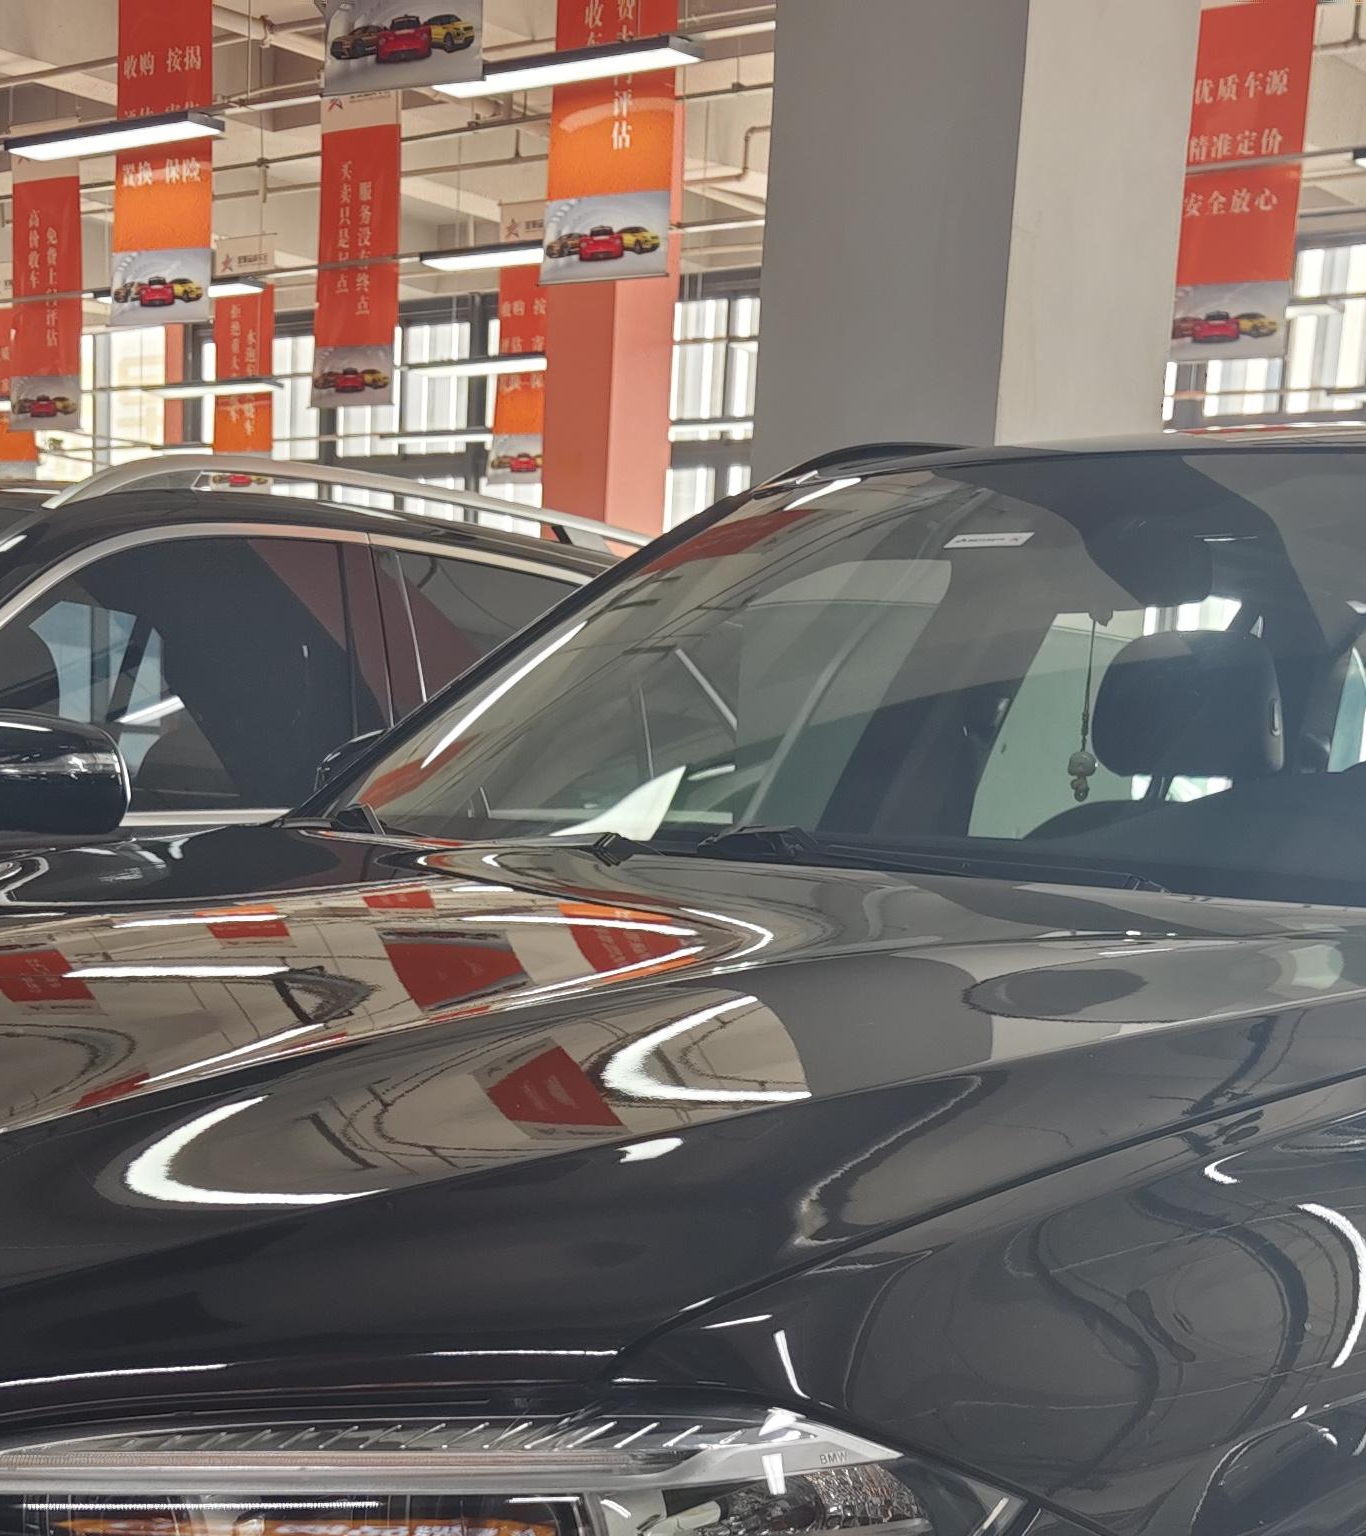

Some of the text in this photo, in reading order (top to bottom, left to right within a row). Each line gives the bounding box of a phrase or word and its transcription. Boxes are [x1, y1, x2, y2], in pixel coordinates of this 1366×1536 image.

[123, 45, 202, 79] 收购 按揭
[1195, 68, 1290, 105] 优质车源
[1188, 127, 1284, 162] 精准定价
[164, 157, 202, 185] 保险
[1185, 187, 1279, 217] 安全放心
[819, 1450, 849, 1465] BMW
